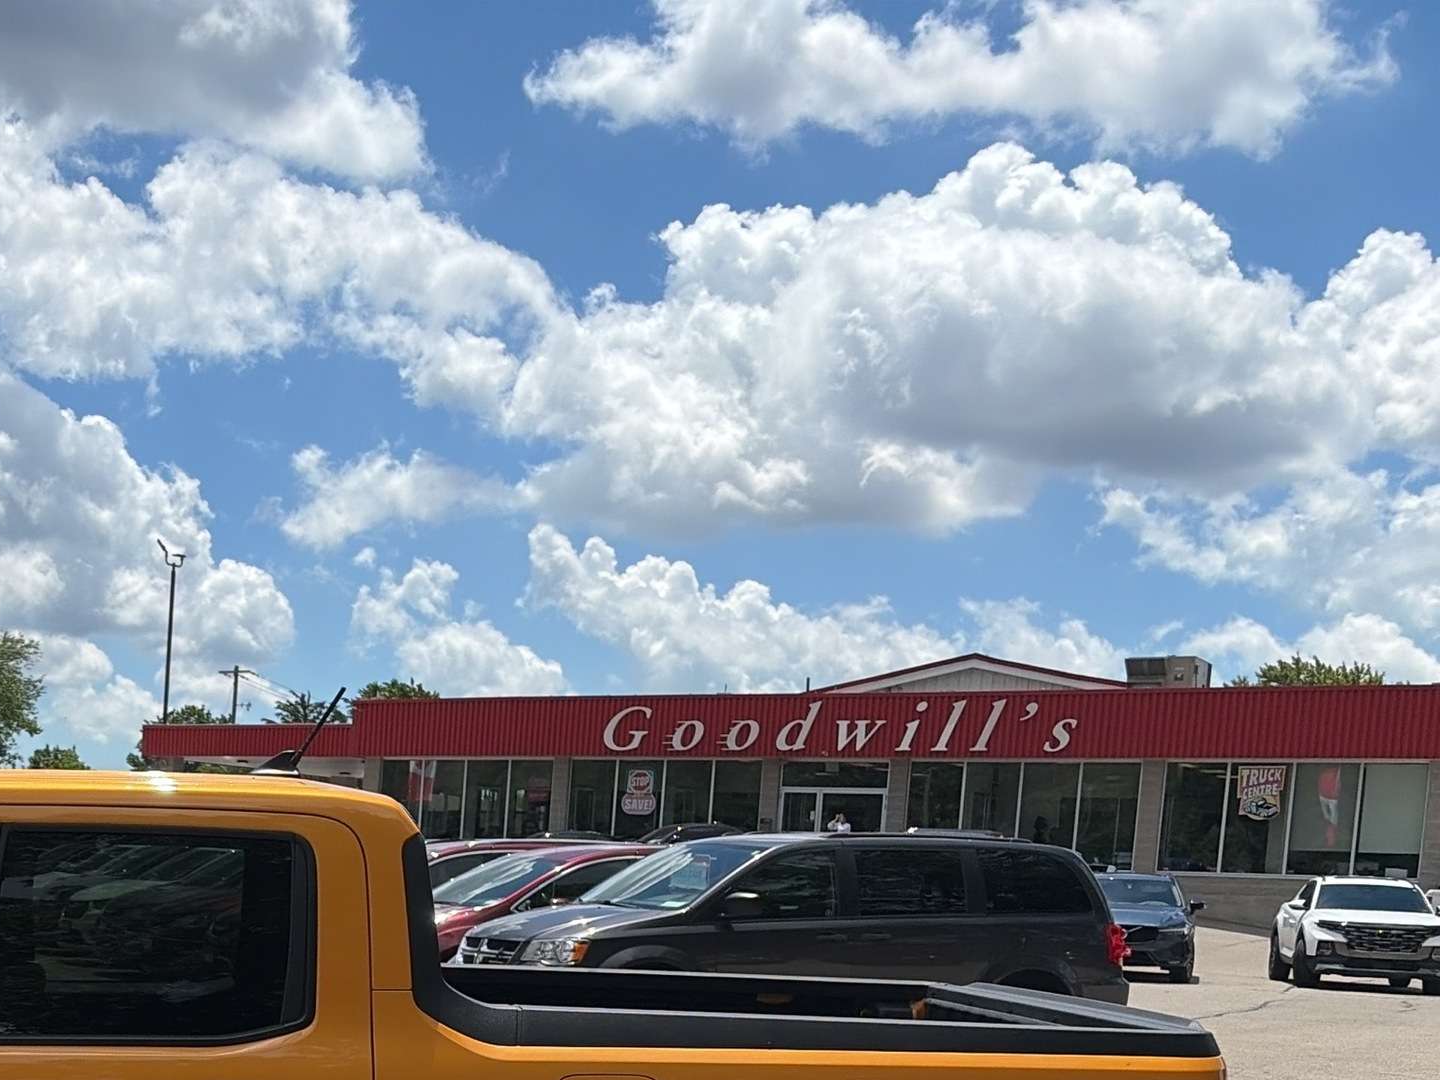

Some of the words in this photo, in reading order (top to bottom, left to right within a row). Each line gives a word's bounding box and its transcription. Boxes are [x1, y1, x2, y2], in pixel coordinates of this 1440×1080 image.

[603, 700, 1077, 752] Goodwill's
[1241, 769, 1281, 786] TRUCK
[1242, 783, 1278, 800] CENTRE
[624, 799, 654, 810] SAVE!
